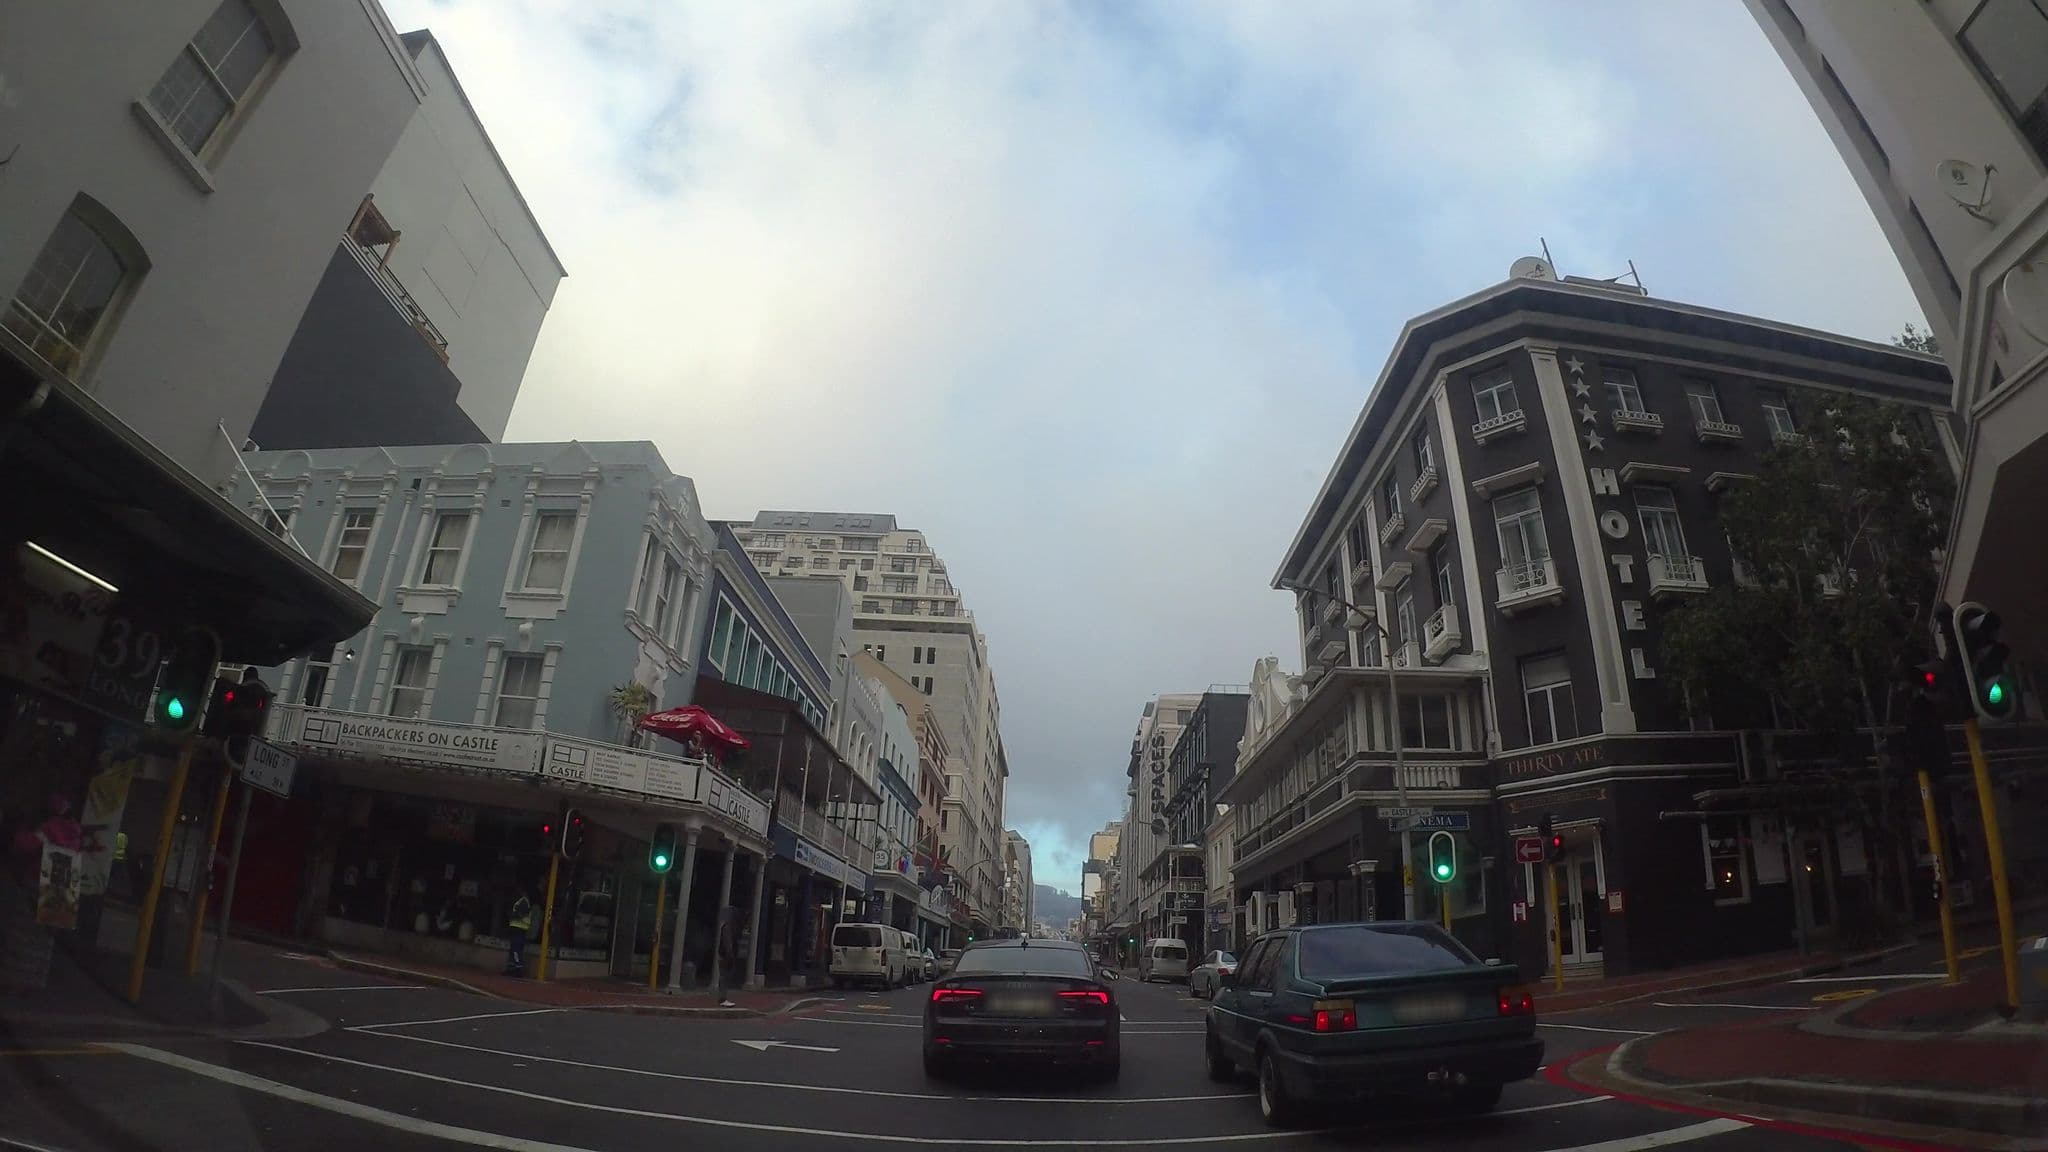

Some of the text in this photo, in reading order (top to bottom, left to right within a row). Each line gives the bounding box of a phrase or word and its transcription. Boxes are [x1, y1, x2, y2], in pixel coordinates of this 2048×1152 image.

[1590, 467, 1656, 679] HOTEL
[342, 722, 498, 751] BACKPACKERS ON CASTLE
[255, 745, 280, 769] LONG
[1505, 751, 1564, 775] THIRTY
[550, 764, 584, 779] CASTLE
[728, 799, 751, 824] CASTLE
